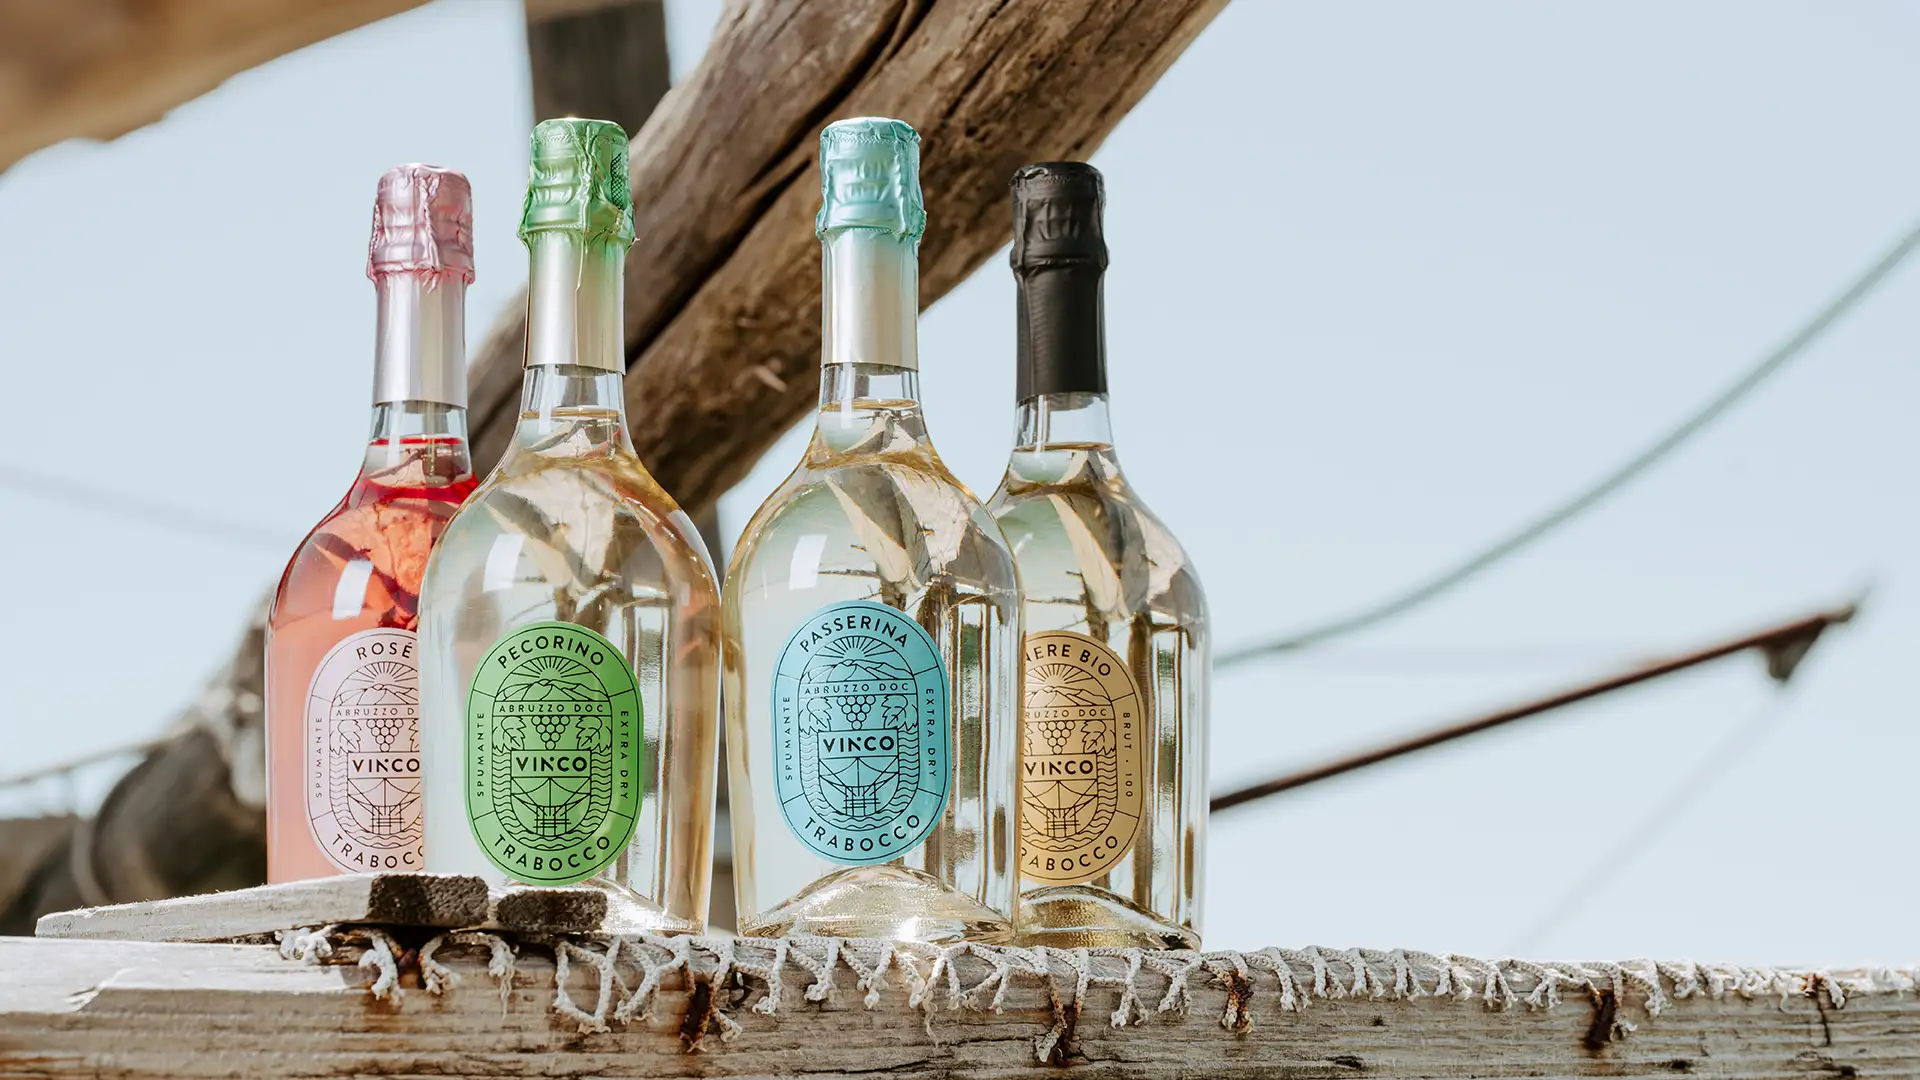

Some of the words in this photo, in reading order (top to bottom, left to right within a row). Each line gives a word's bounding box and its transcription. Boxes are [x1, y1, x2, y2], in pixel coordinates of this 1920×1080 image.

[799, 615, 908, 653] PASSERINA
[356, 642, 413, 660] ROSÉ
[498, 635, 604, 669] PECORINO
[1079, 649, 1111, 677] BIO
[804, 683, 870, 695] ABRUZZO
[879, 682, 909, 692] DOC
[336, 707, 398, 717] ABRUZZO
[499, 704, 565, 713] ABRUZZO
[574, 704, 604, 713] DOC
[925, 688, 936, 738] EXTRA
[1078, 708, 1107, 717] DOC
[620, 710, 629, 760] EXTRA
[782, 696, 793, 781] SPUMANTE
[823, 735, 895, 753] VINCO
[1122, 712, 1132, 750] BRUT
[315, 718, 323, 798] SPUMANTE
[352, 758, 420, 773] VINCO
[477, 713, 485, 797] SPUMANTE
[516, 757, 587, 772] VINCO
[927, 747, 937, 777] DRY
[1024, 760, 1094, 776] VINCO
[620, 769, 629, 800] DRY
[1124, 772, 1134, 798] 100
[804, 814, 920, 852] TRABOCCO
[493, 834, 610, 872] TRABOCCO
